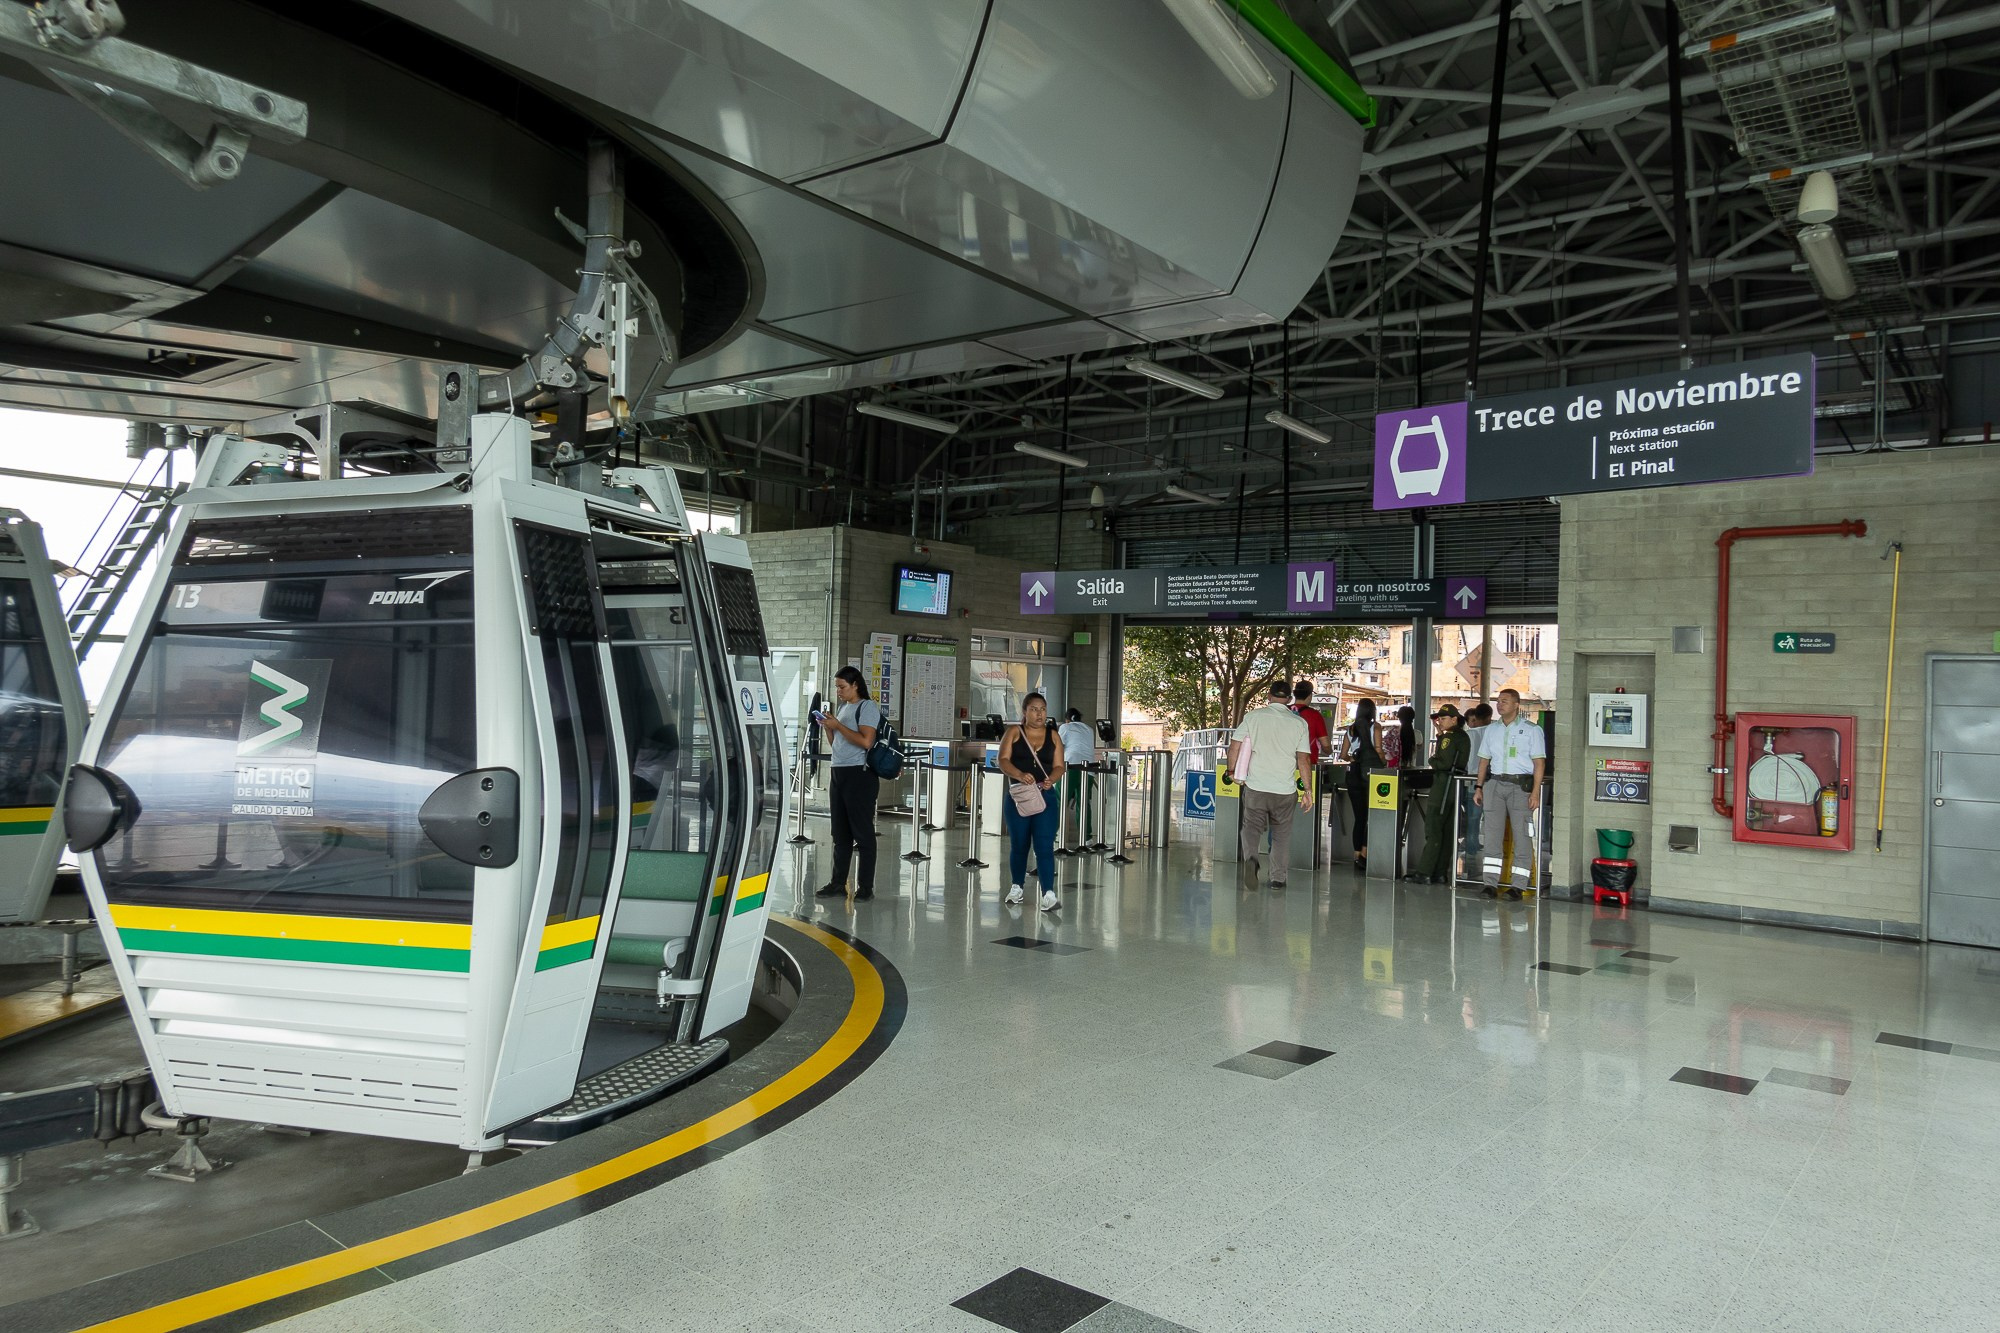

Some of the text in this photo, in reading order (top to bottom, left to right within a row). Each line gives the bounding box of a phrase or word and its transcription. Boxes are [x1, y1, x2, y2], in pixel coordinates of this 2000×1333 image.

[1475, 371, 1800, 433] Trece de Noviembre
[1610, 419, 1715, 442] Próxima estación
[1610, 438, 1678, 456] Next station
[1610, 458, 1674, 478] El Pinal
[1077, 578, 1124, 596] Salida
[1296, 571, 1324, 603] M
[1336, 582, 1430, 592] ar con nosotros
[175, 584, 202, 609] 13
[368, 590, 424, 605] POMA
[1093, 598, 1107, 606] Exit
[1336, 594, 1367, 602] raveling
[238, 767, 310, 786] METRO
[237, 788, 252, 797] DE
[232, 805, 312, 816] CALIDAD DE VIDA
